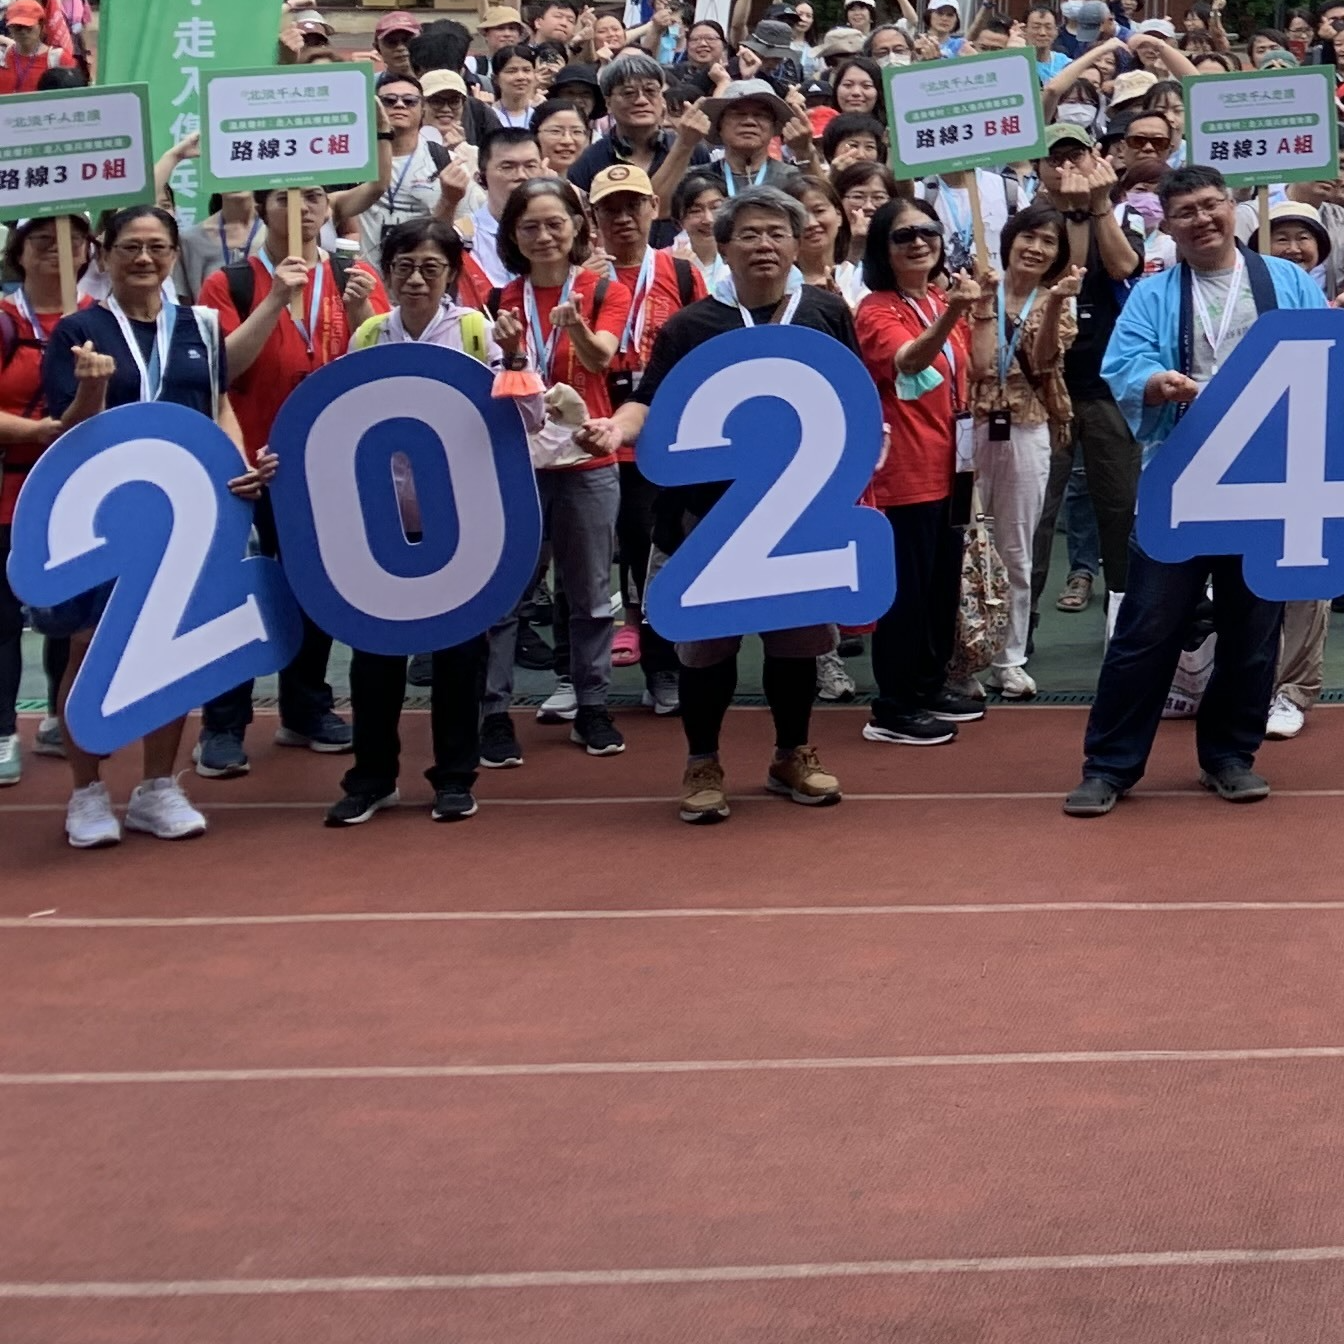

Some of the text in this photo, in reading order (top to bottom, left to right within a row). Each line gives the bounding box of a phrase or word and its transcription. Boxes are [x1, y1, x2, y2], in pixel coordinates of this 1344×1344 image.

[916, 115, 1021, 149] 路線3 B組
[230, 134, 350, 162] 路線3 C組
[1210, 134, 1313, 161] 路線3 A組
[0, 158, 126, 190] 路線3 D組
